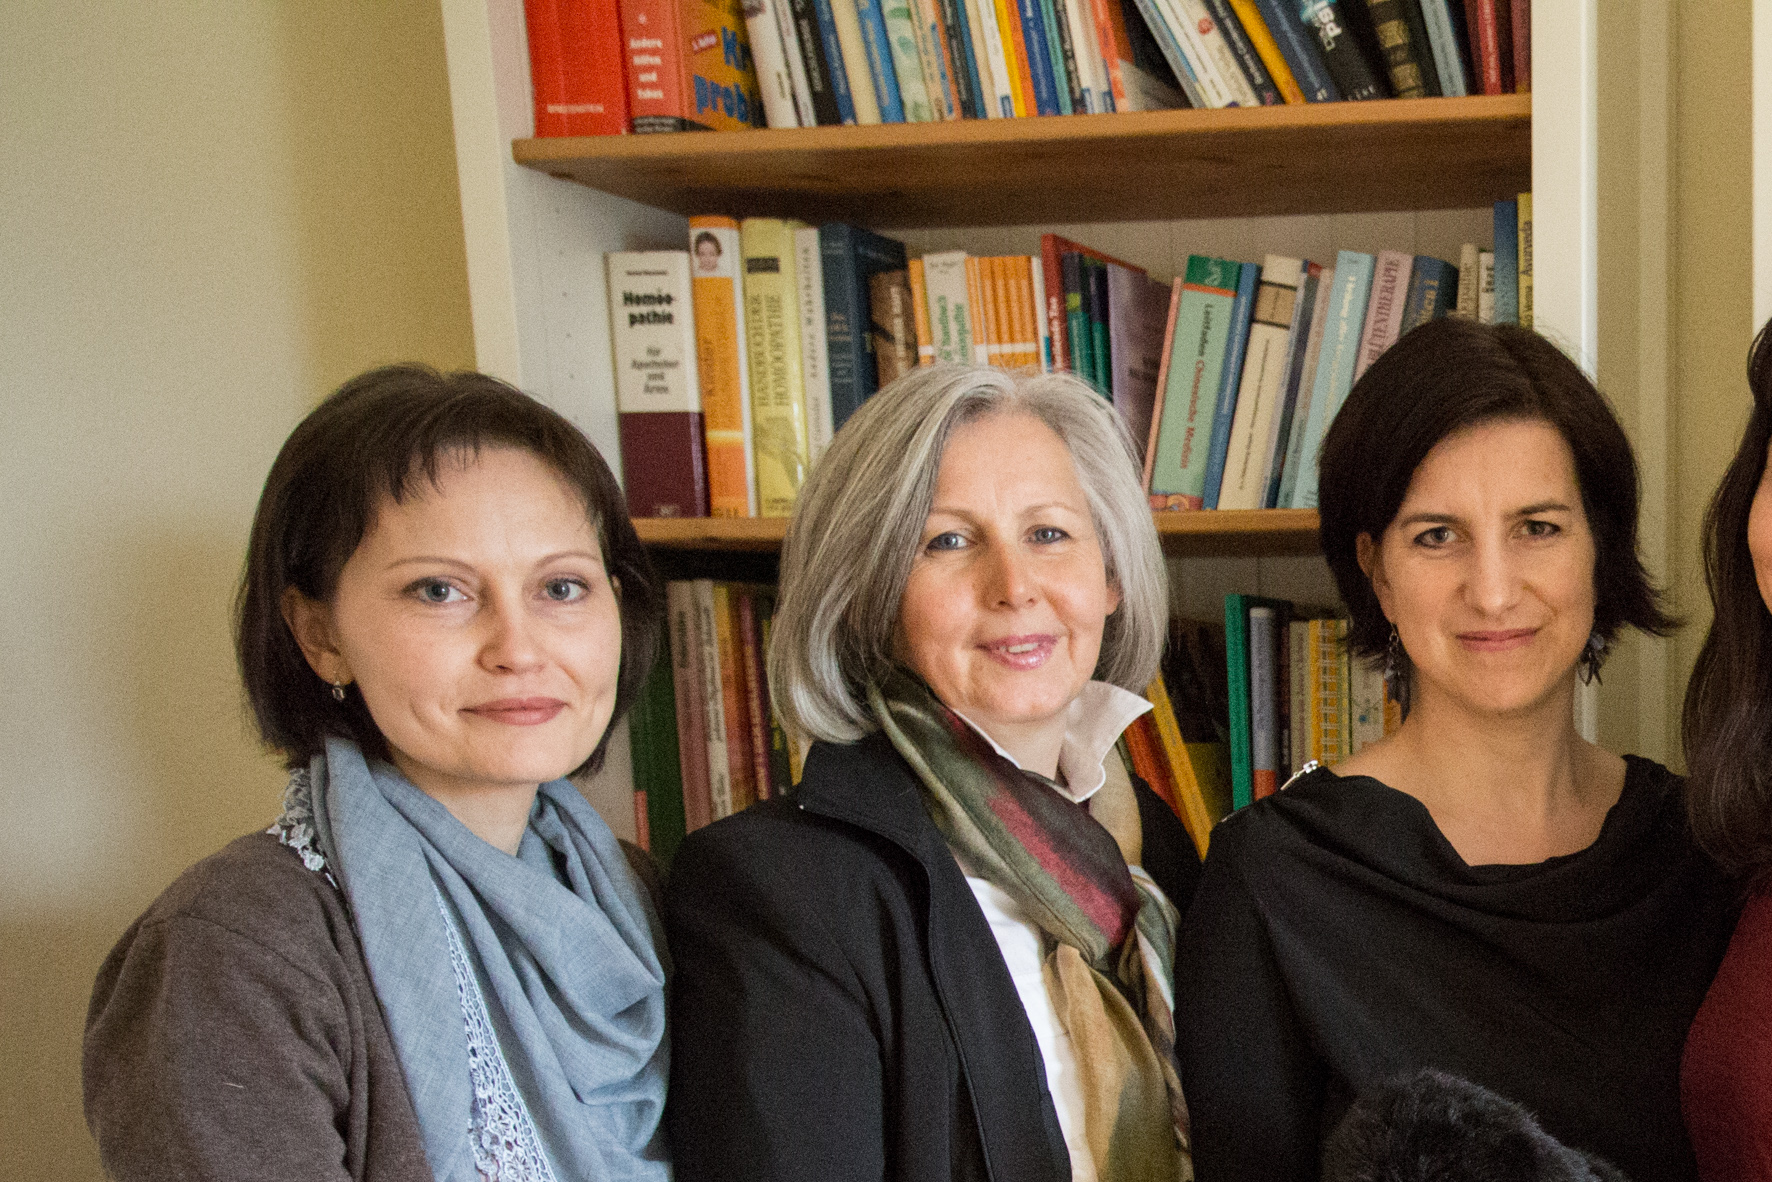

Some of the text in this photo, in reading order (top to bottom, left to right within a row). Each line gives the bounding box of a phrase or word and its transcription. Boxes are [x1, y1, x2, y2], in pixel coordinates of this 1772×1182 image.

[1520, 220, 1532, 277] Ayurveda
[623, 287, 675, 306] Homöo-
[628, 309, 673, 328] pathie
[764, 294, 790, 407] HOMÖOPATHIE
[1180, 303, 1214, 470] Leitfaden Chinesische Medizin
